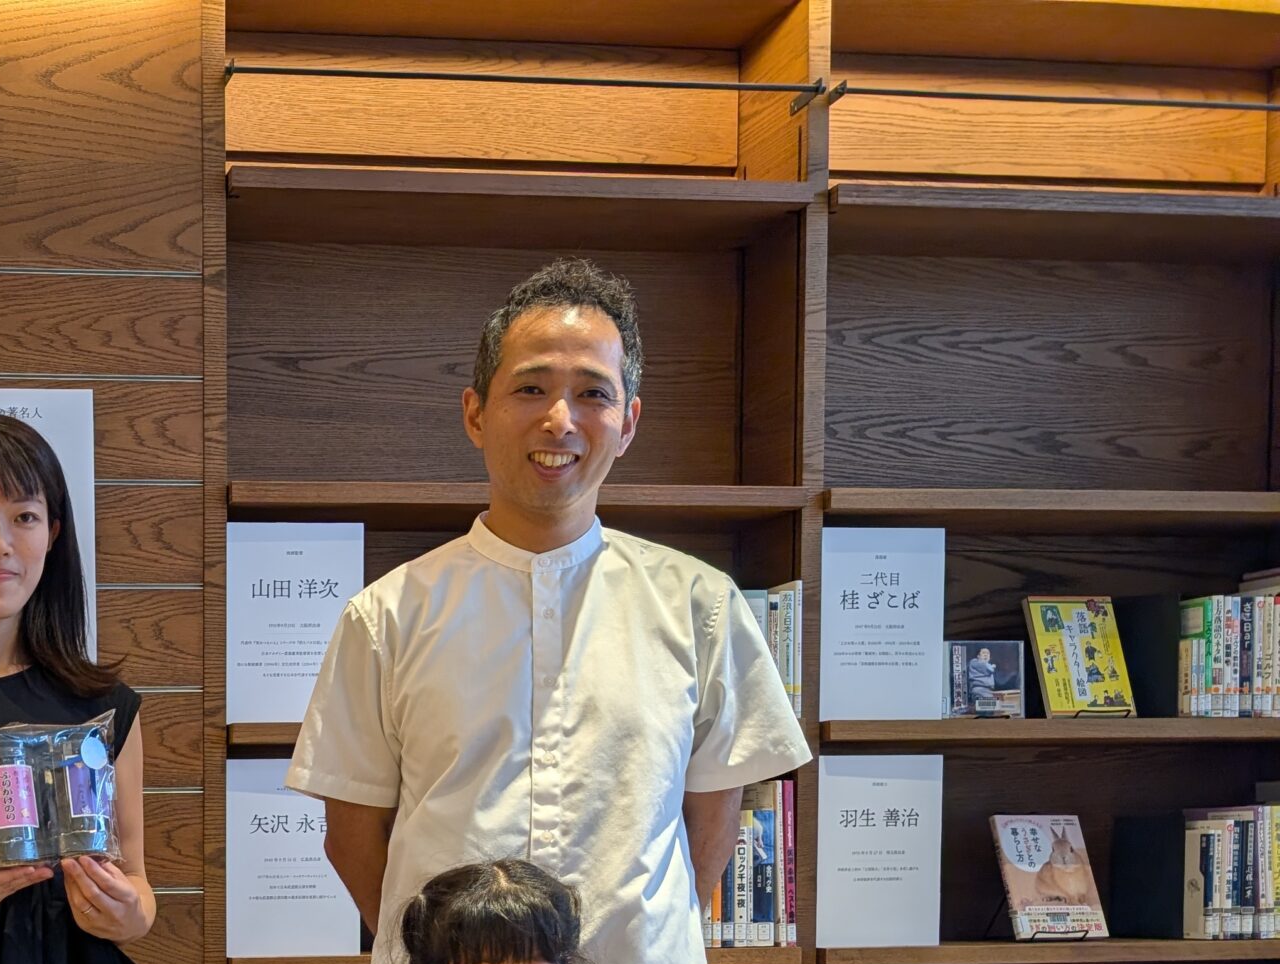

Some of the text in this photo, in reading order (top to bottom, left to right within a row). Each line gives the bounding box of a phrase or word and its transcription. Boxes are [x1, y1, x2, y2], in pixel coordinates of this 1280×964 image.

[252, 579, 339, 599] 山田 洋次
[860, 572, 900, 586] 二代目
[840, 590, 921, 610] 桂 ざこば
[1075, 611, 1089, 634] 落語
[1065, 625, 1082, 676] キャラクター
[250, 814, 290, 834] 矢沢
[839, 809, 920, 828] 羽生 善治
[1010, 828, 1024, 862] 暮らし方
[1030, 828, 1041, 852] 幸せな
[737, 847, 746, 908] ロック千夜一夜
